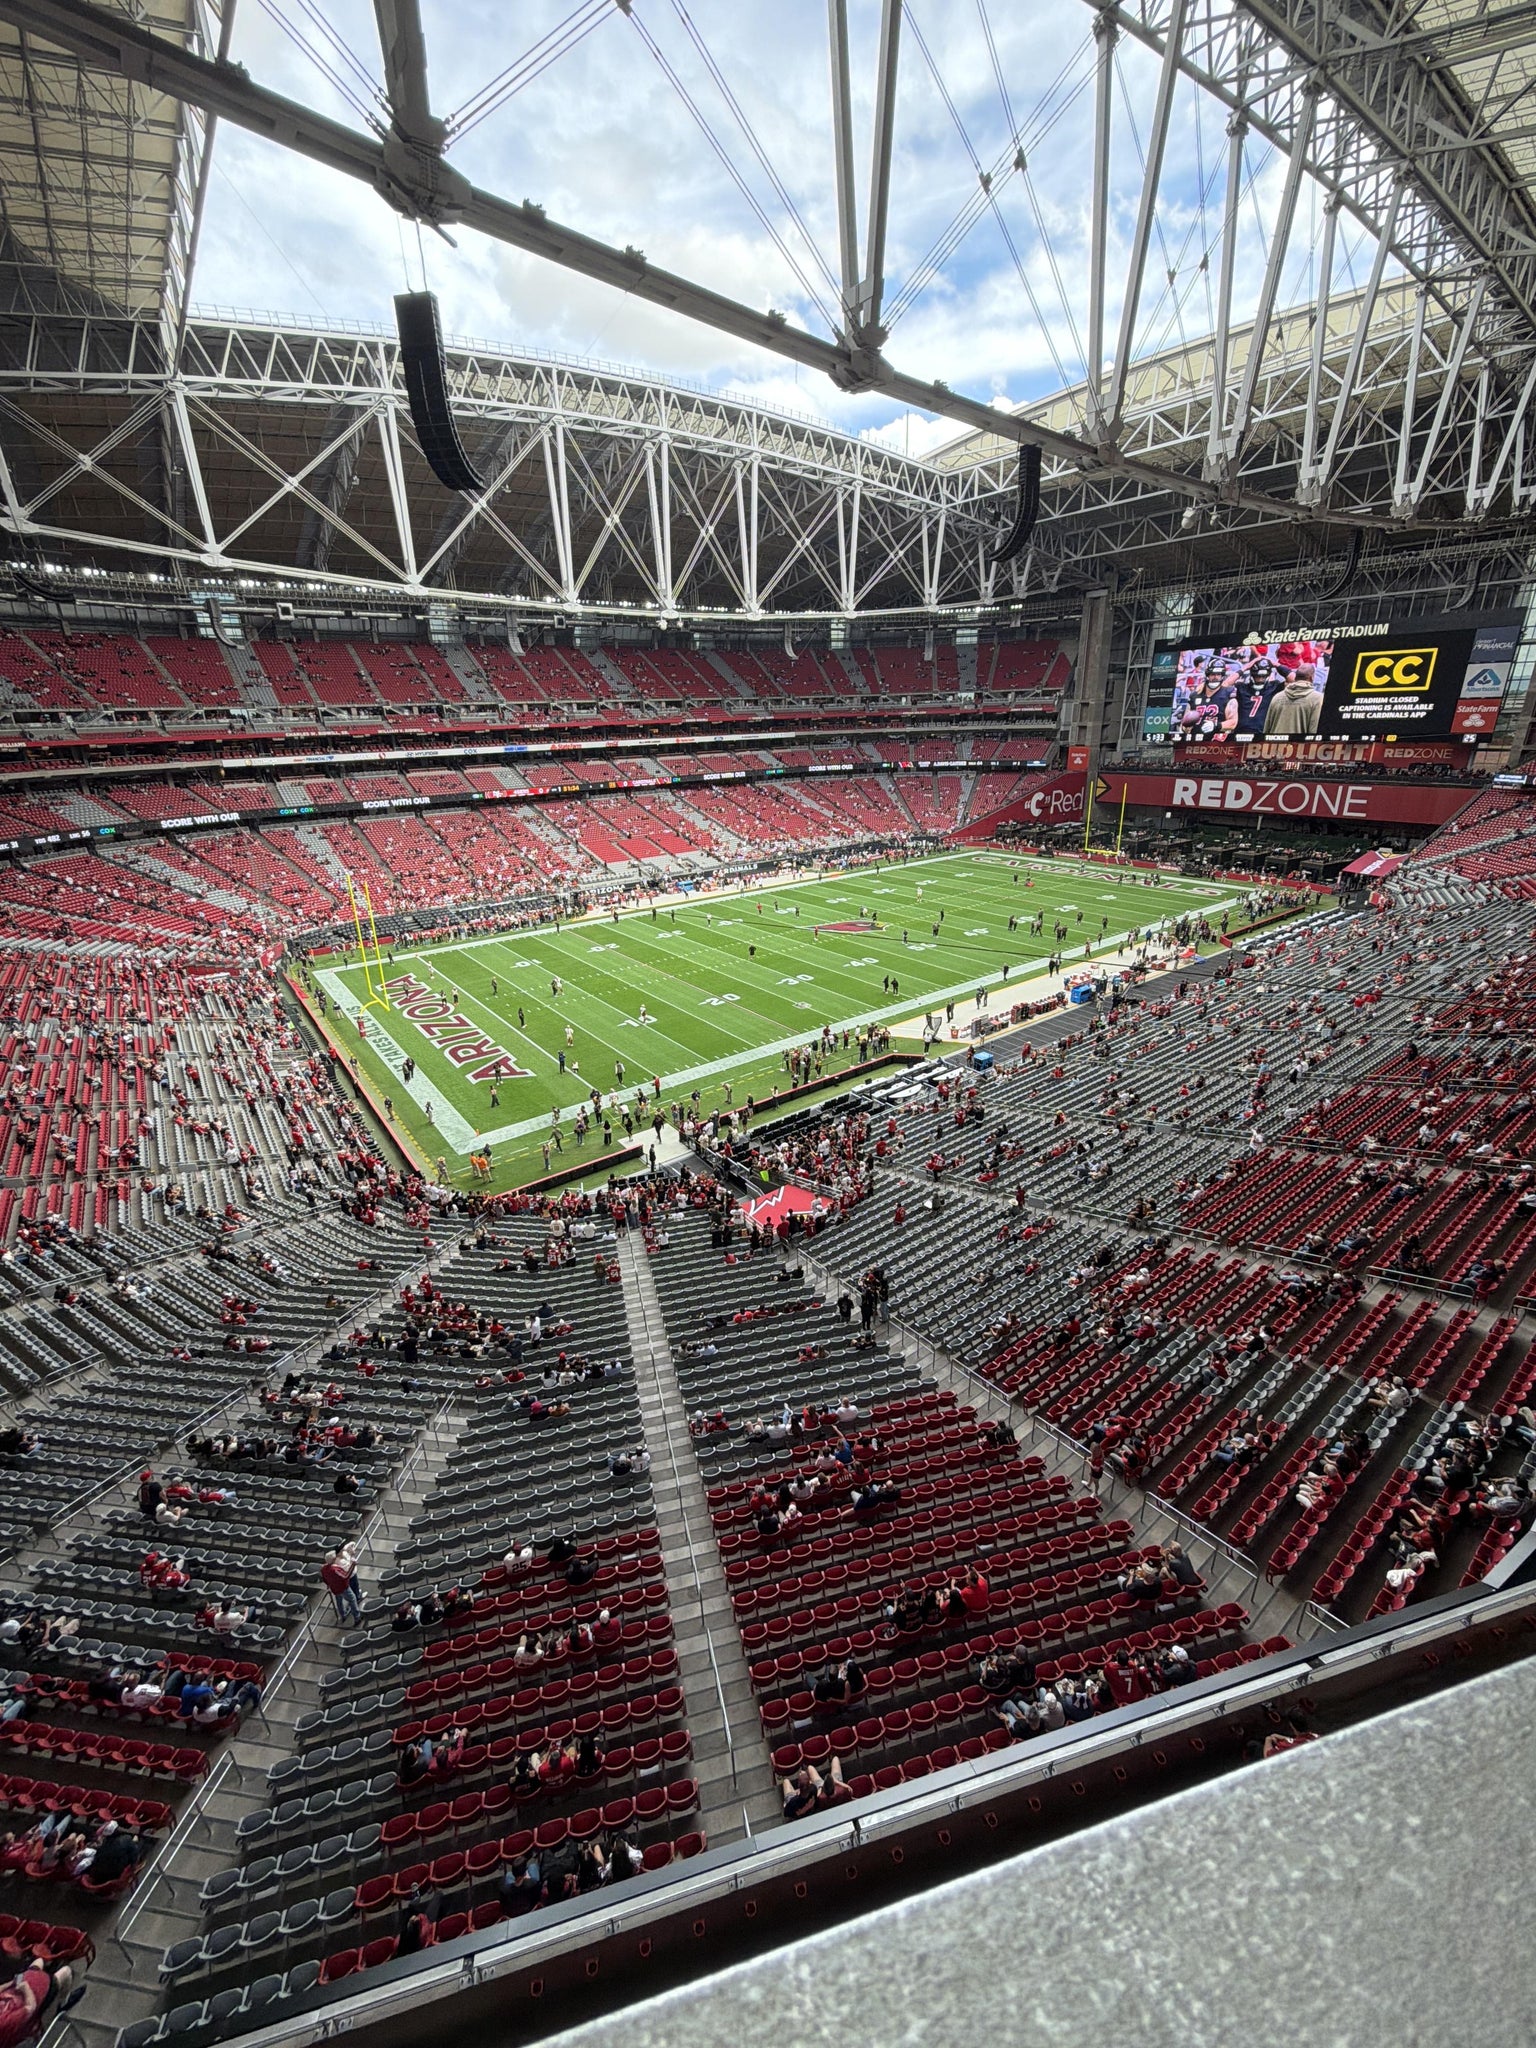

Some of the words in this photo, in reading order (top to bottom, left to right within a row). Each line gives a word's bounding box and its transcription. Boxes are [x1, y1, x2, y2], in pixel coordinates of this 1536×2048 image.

[1332, 623, 1389, 639] STADIUM
[1365, 655, 1423, 686] CC
[1250, 696, 1263, 718] 7
[1146, 716, 1170, 725] COX
[1186, 746, 1235, 755] REDZONE
[1246, 743, 1294, 760] BUD
[1296, 742, 1369, 759] LIGHT
[1384, 748, 1454, 758] REDZONE
[363, 801, 390, 809] SCORE
[391, 798, 412, 807] WITH
[413, 797, 431, 805] OUR
[1050, 786, 1085, 814] Red
[1172, 778, 1373, 818] REDZONE
[161, 818, 194, 828] SCORE
[196, 814, 219, 824] WITH
[220, 812, 240, 822] OUR
[850, 957, 880, 967] 40
[782, 974, 815, 986] 30
[705, 993, 741, 1006] 20
[376, 972, 537, 1085] ARIZONA
[372, 1036, 405, 1063] TAKES
[512, 1560, 527, 1573] 25
[1124, 1678, 1132, 1694] 7
